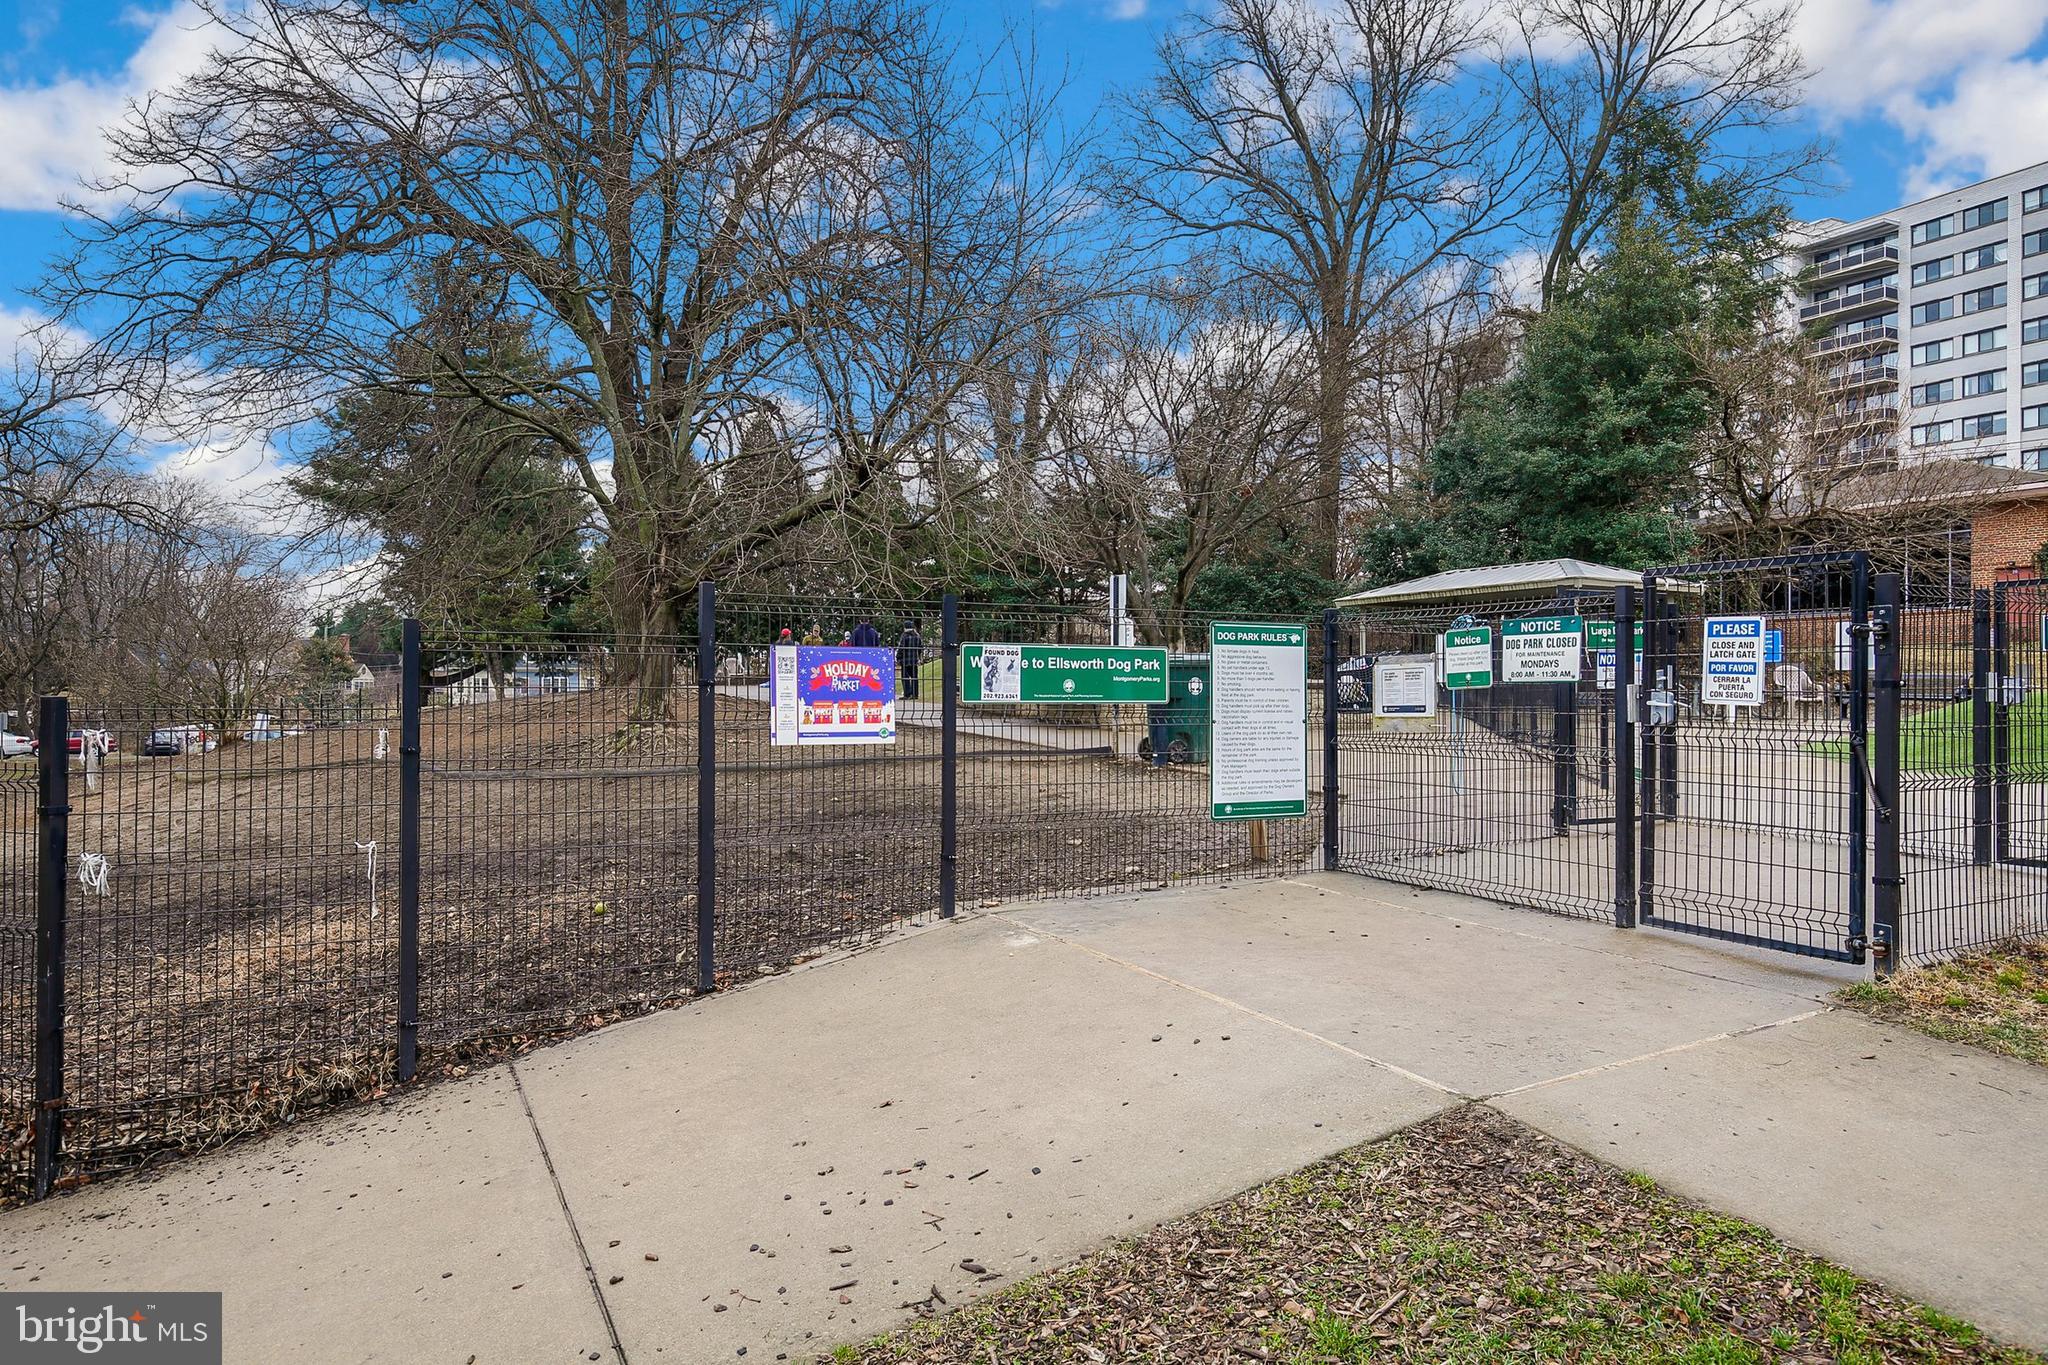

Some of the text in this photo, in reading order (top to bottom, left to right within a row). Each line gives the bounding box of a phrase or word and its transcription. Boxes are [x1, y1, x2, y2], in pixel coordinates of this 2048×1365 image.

[1520, 620, 1561, 632] NOTICE
[1712, 624, 1755, 635] PLEASE
[1217, 632, 1287, 641] DOG PARK RULES
[1454, 636, 1481, 645] Notice
[1505, 637, 1577, 650] DOG PARK CLOSED
[823, 661, 869, 678] HOLIDAY
[1032, 658, 1045, 668] to
[1048, 657, 1104, 669] Ellsworth
[1108, 658, 1131, 672] Dog
[1134, 658, 1160, 670] Park
[1520, 660, 1559, 668] MONDAYS
[1711, 664, 1754, 672] POR FAVOR
